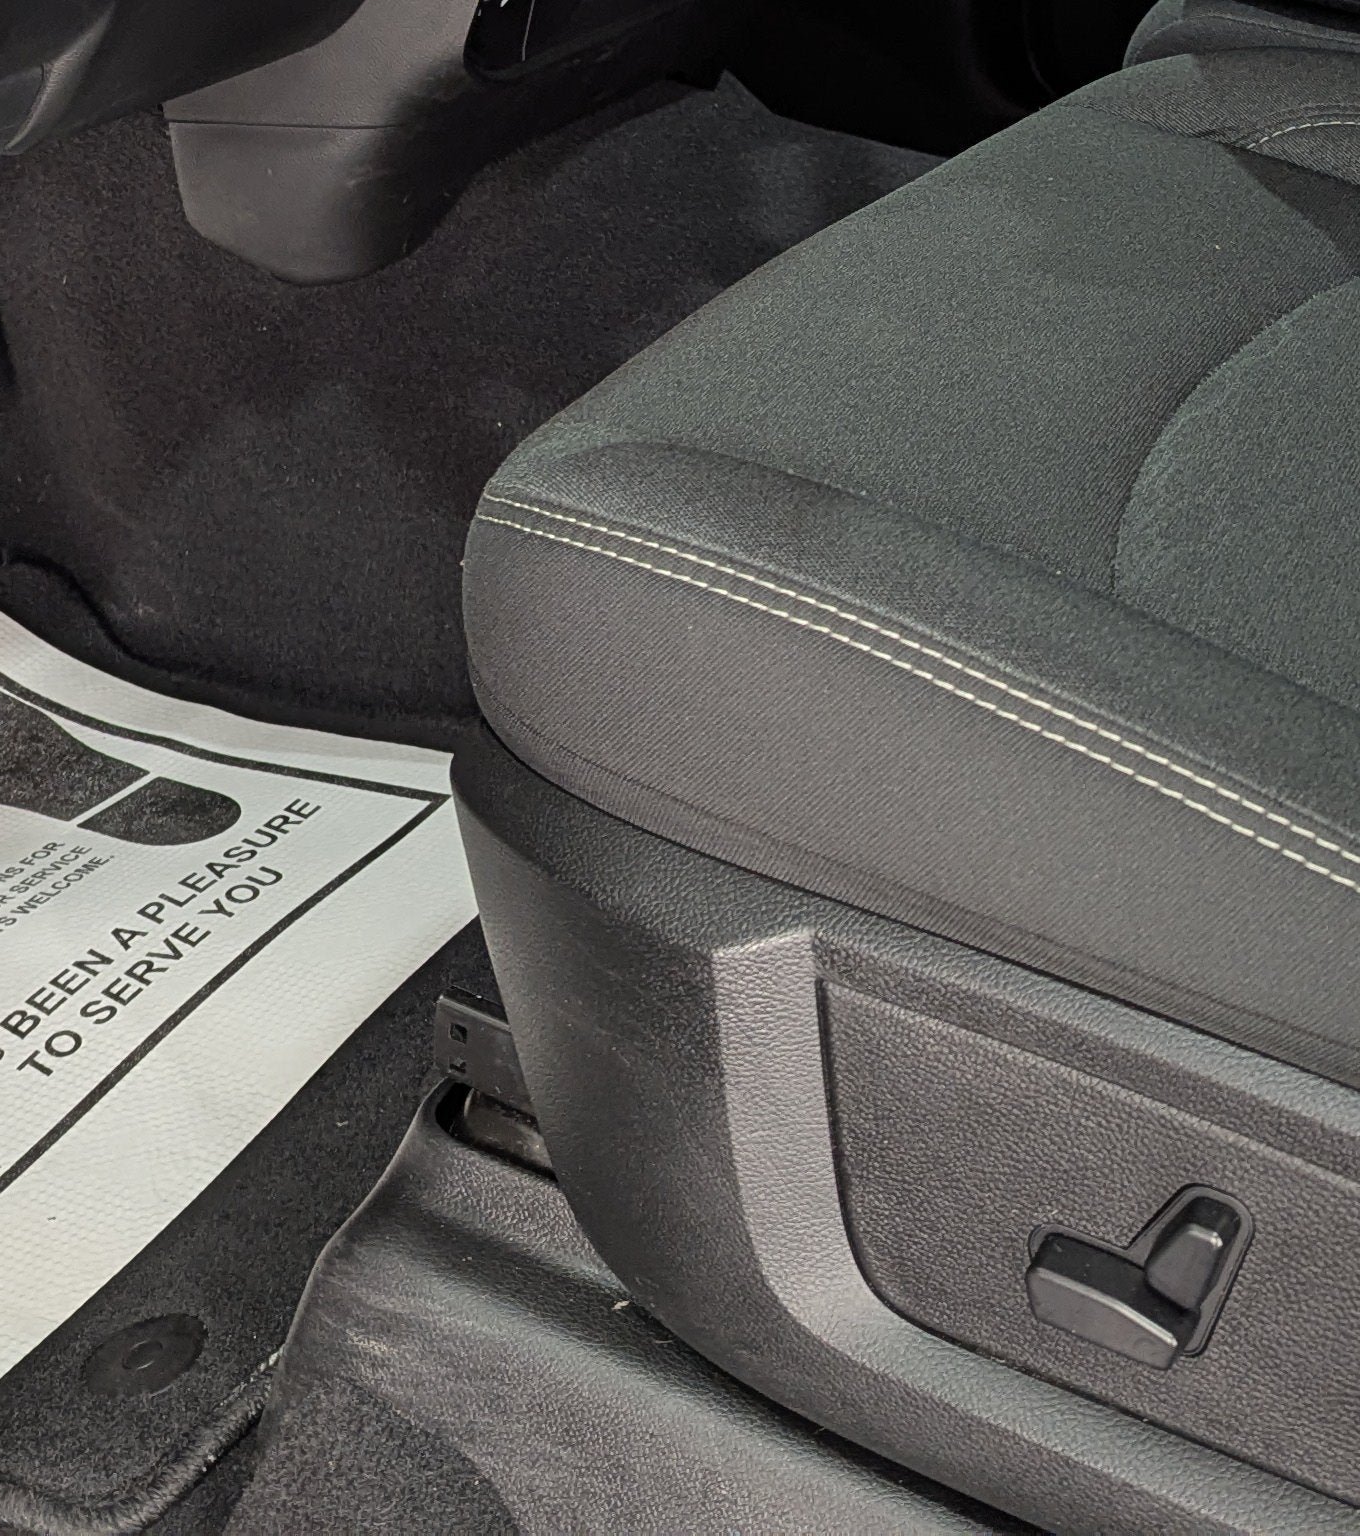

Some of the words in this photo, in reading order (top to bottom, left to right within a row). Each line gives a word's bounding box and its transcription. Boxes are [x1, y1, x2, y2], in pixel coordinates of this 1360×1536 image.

[9, 845, 93, 895] SERVICE
[10, 854, 115, 915] WELCOME.
[19, 841, 65, 867] FOR
[0, 948, 115, 1040] BEEN
[109, 925, 149, 951] A
[136, 798, 323, 926] PLEASURE
[16, 1029, 83, 1078] TO
[80, 921, 212, 1025] SERVE
[198, 865, 285, 919] YOU
